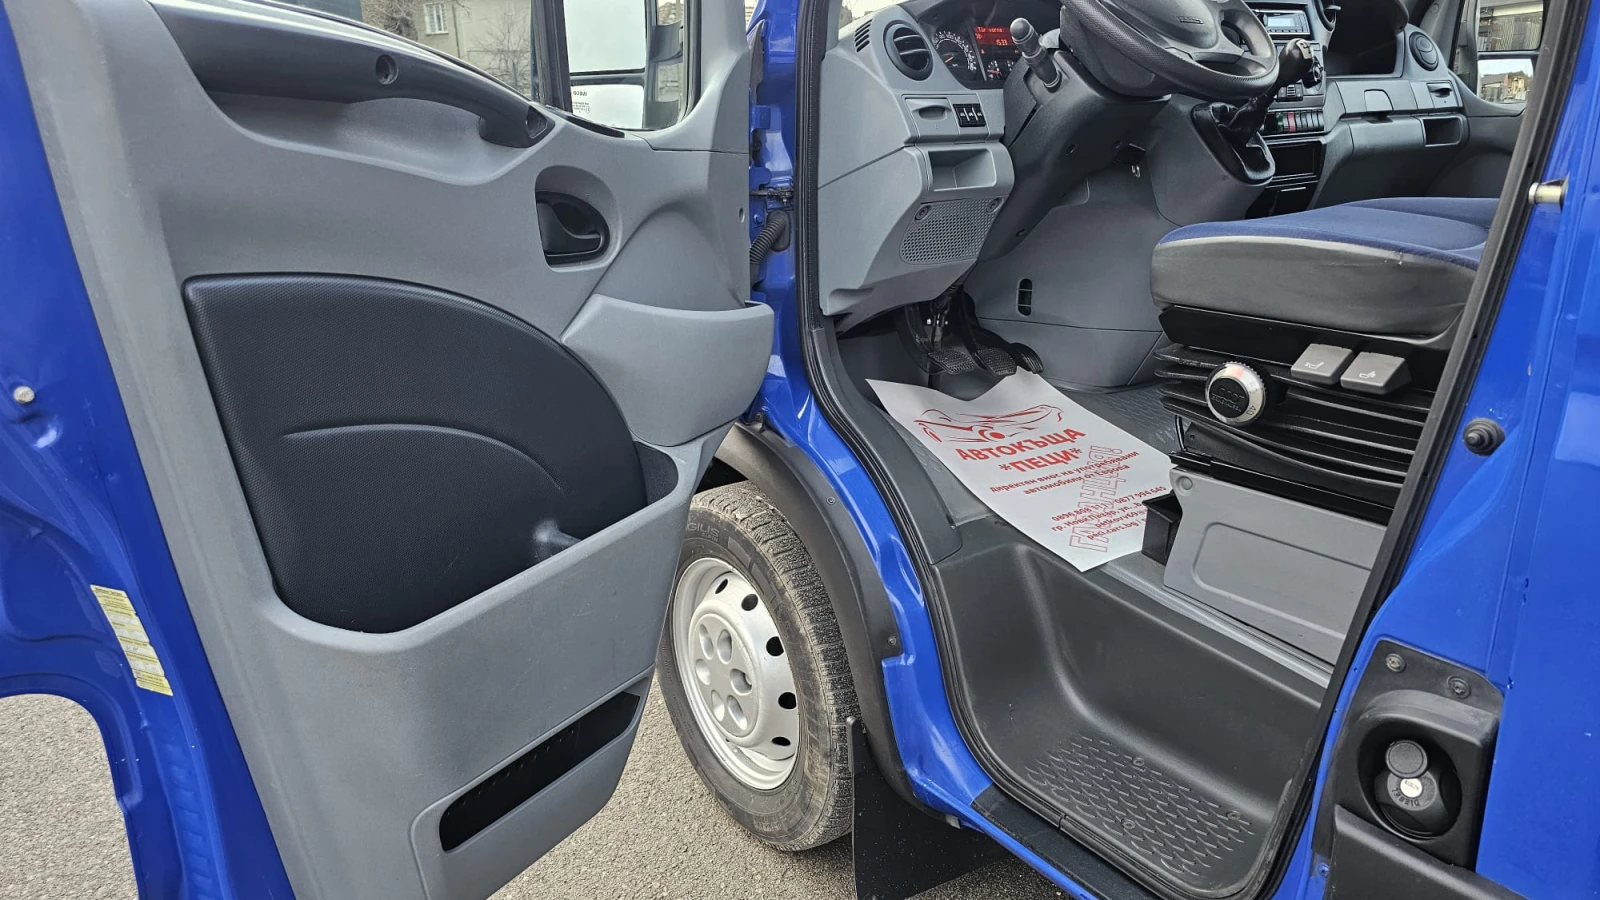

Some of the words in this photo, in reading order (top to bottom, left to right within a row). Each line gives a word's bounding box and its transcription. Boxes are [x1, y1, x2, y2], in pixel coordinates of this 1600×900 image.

[955, 427, 1086, 461] АВТОКЪЩА
[990, 478, 1038, 493] Директен
[1036, 472, 1062, 483] внос
[1023, 475, 1084, 495] автомобили
[1083, 471, 1096, 479] от
[1094, 464, 1131, 477] Европа
[1114, 494, 1135, 505] 0877
